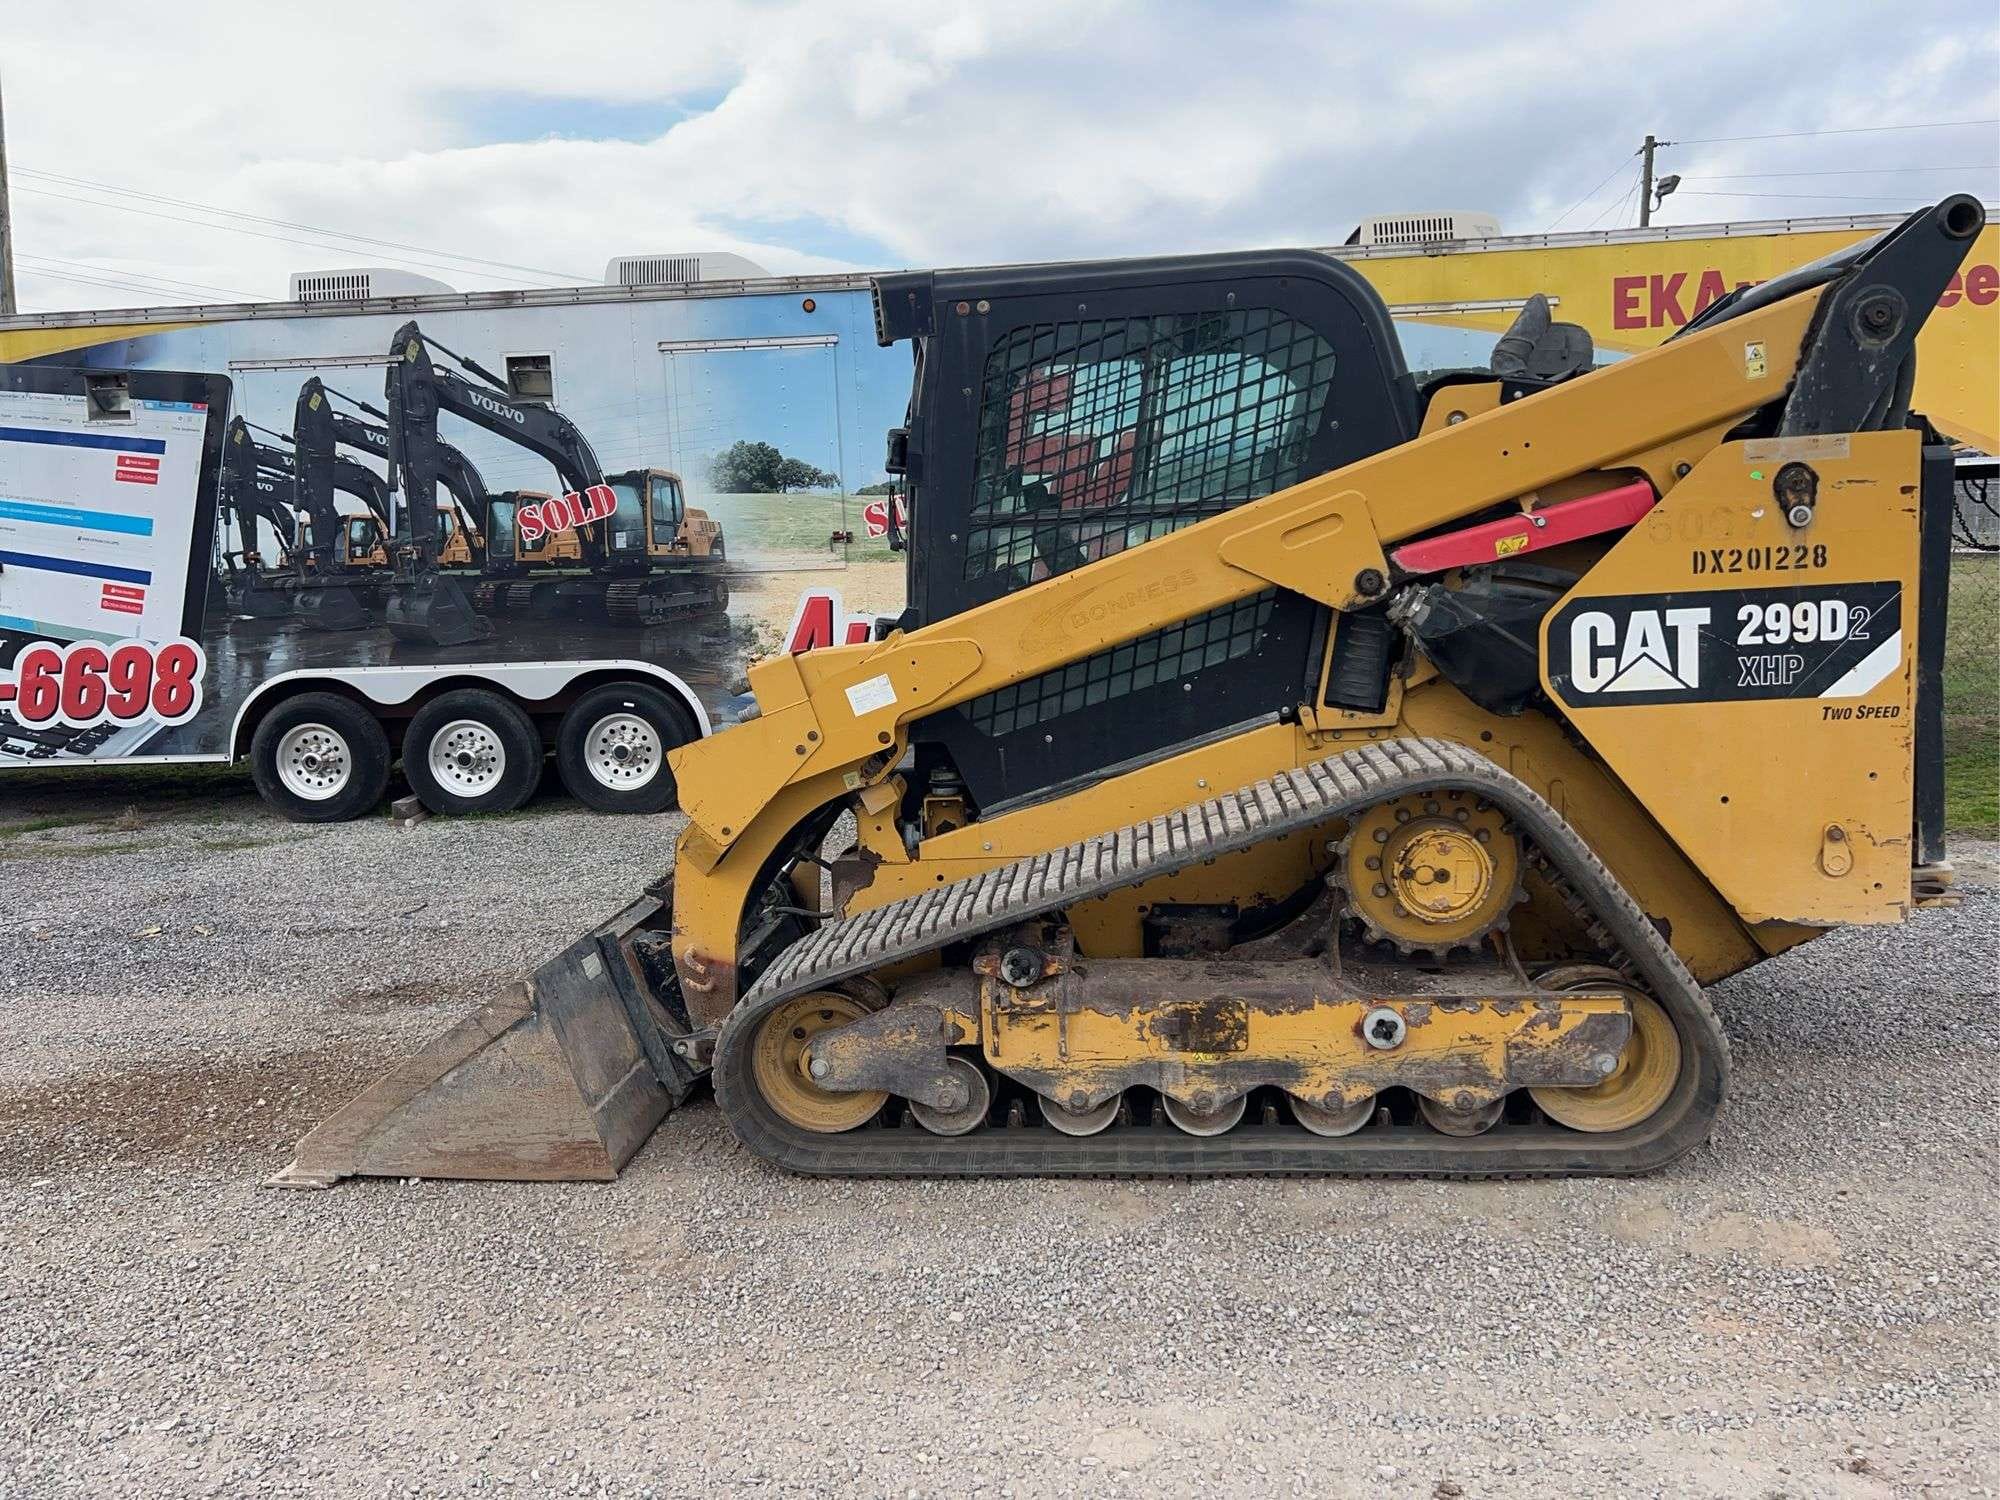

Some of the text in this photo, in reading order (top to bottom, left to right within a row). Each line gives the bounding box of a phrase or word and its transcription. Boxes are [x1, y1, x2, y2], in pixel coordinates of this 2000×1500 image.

[468, 390, 525, 424] VOLVO
[517, 485, 618, 541] SOLD
[1692, 544, 1827, 574] DX201228
[1571, 607, 1711, 693] CAT
[1738, 655, 1804, 687] XHP
